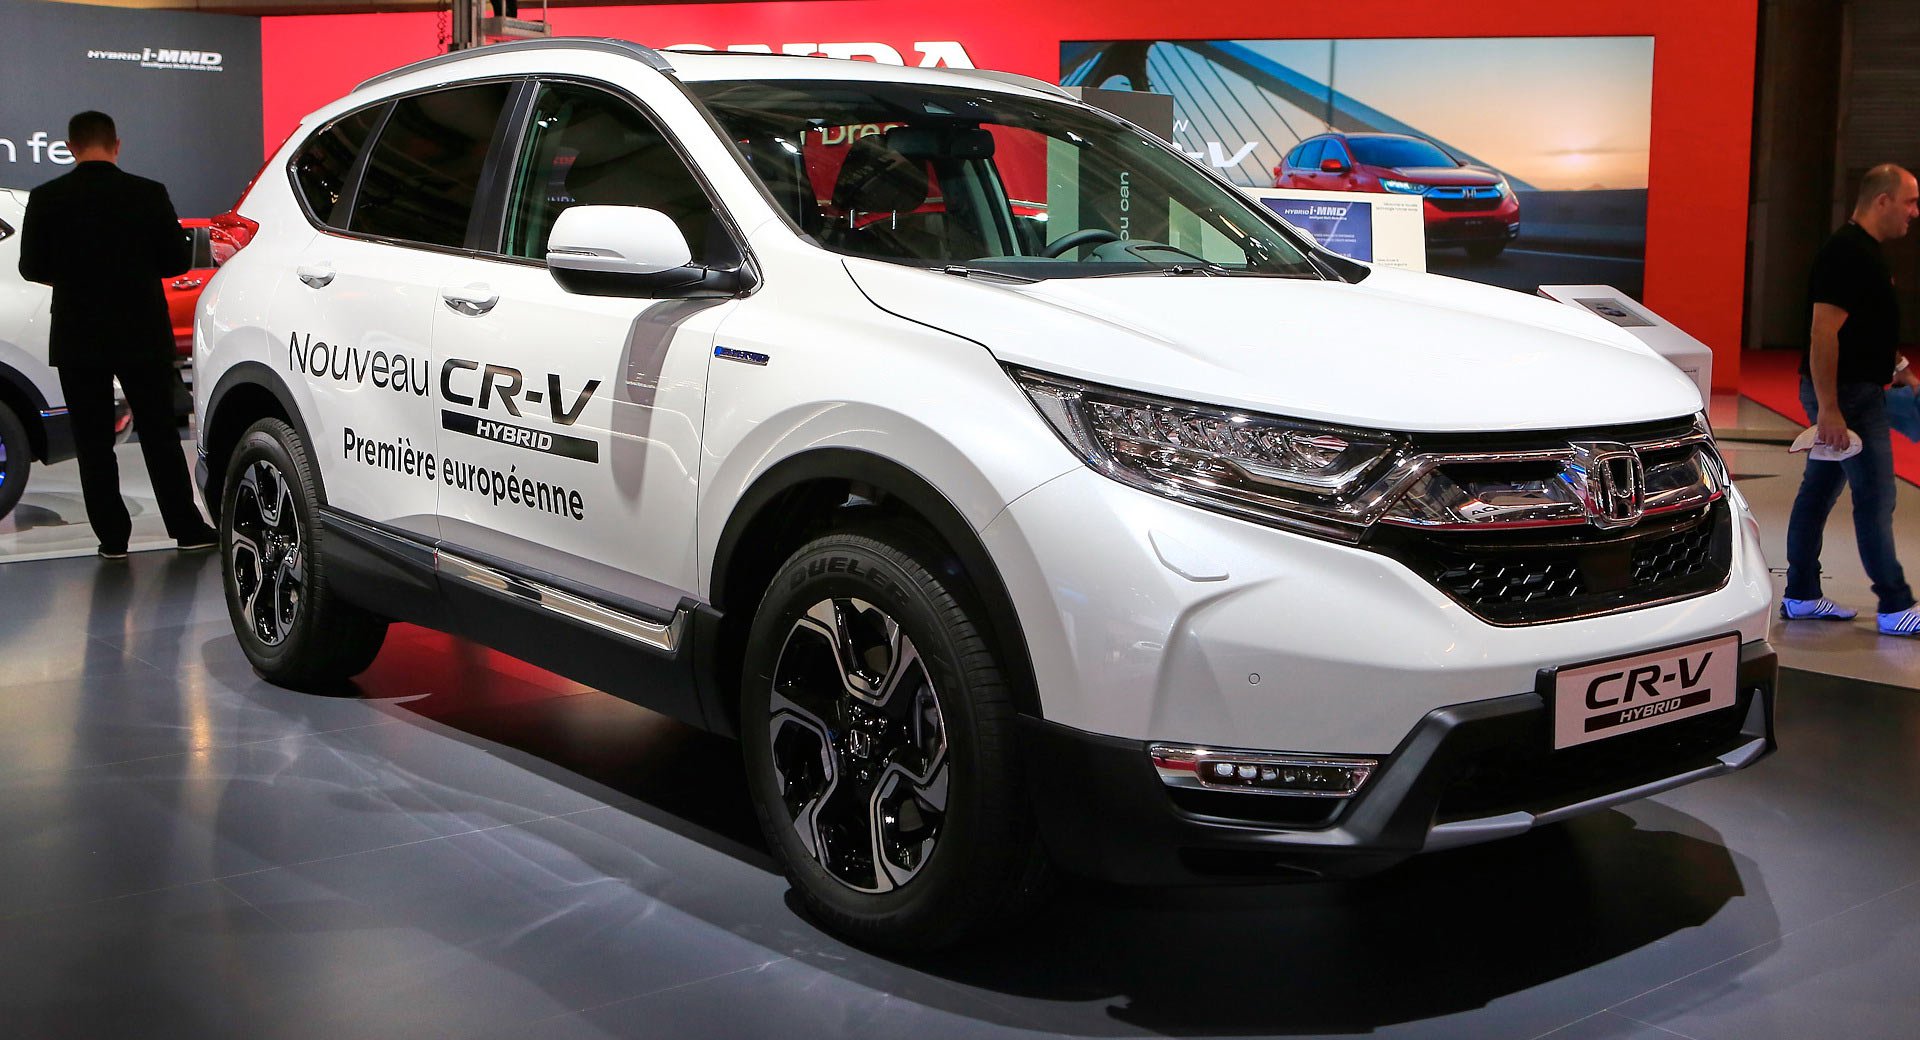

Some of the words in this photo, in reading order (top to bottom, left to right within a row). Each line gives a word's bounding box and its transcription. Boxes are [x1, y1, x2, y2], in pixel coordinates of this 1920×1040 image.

[87, 50, 141, 61] HYBRID
[1120, 171, 1130, 212] can
[288, 331, 430, 397] Nouveau
[440, 358, 602, 426] CR-V
[476, 419, 553, 451] HYBRID
[343, 426, 437, 481] Première
[442, 457, 585, 522] européenne
[1585, 651, 1714, 710] CR-V
[1619, 698, 1682, 723] HYBRID
